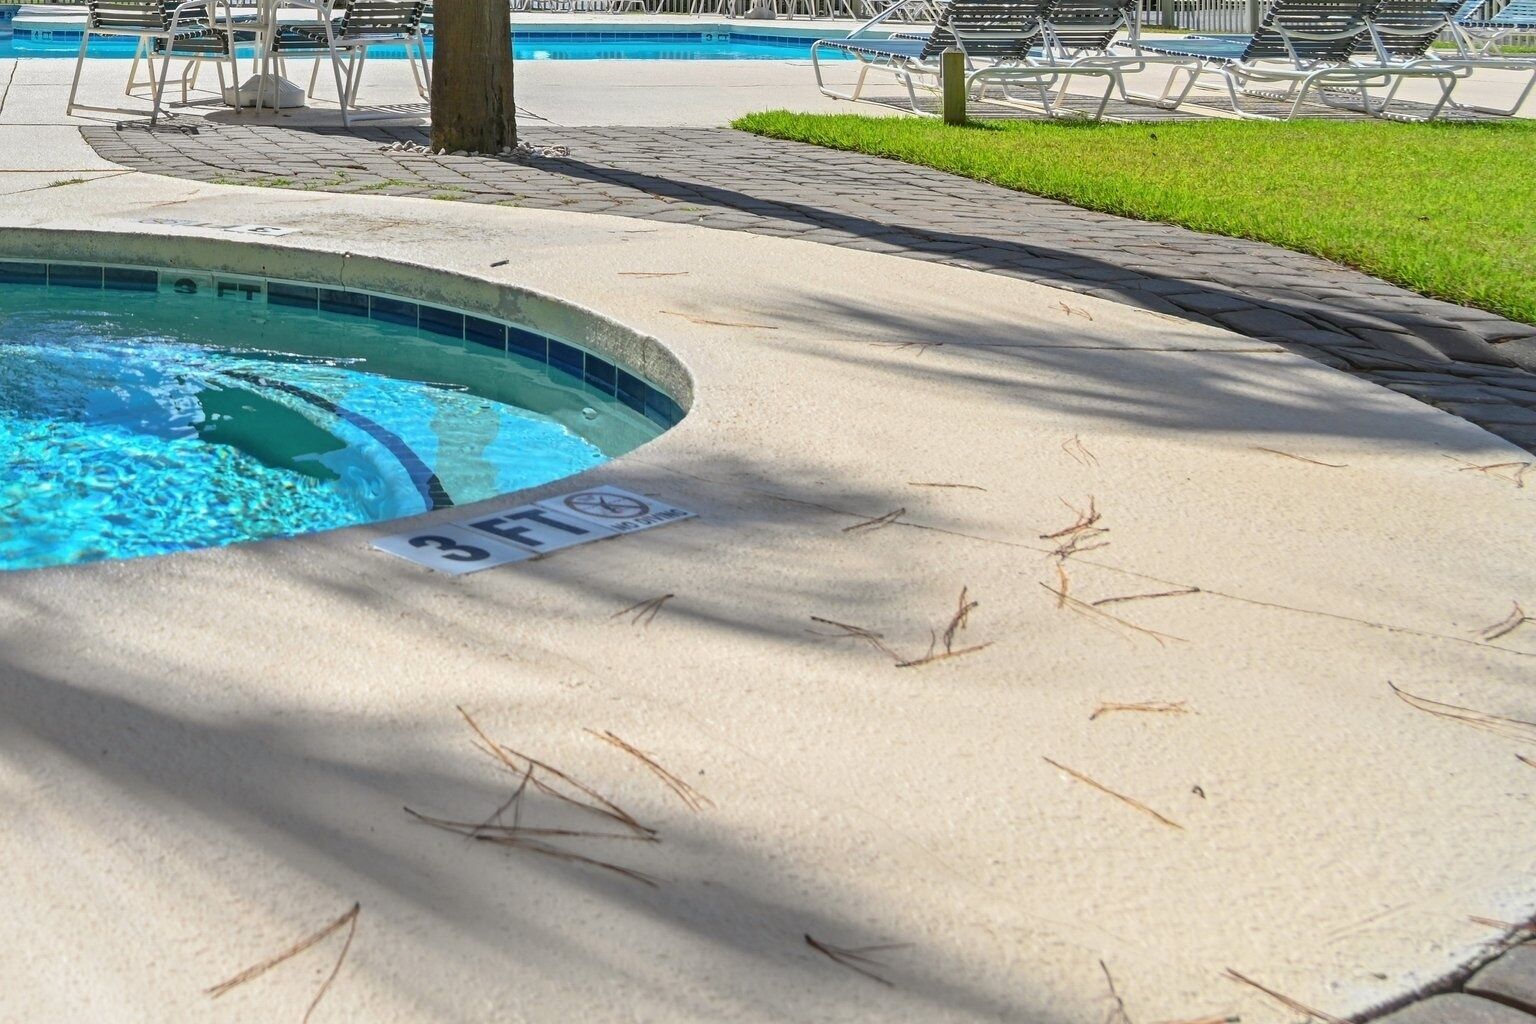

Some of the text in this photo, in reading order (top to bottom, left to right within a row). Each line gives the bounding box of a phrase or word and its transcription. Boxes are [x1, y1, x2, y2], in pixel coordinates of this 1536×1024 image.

[407, 508, 591, 563] 3 FT
[610, 508, 688, 532] NO DIVING
